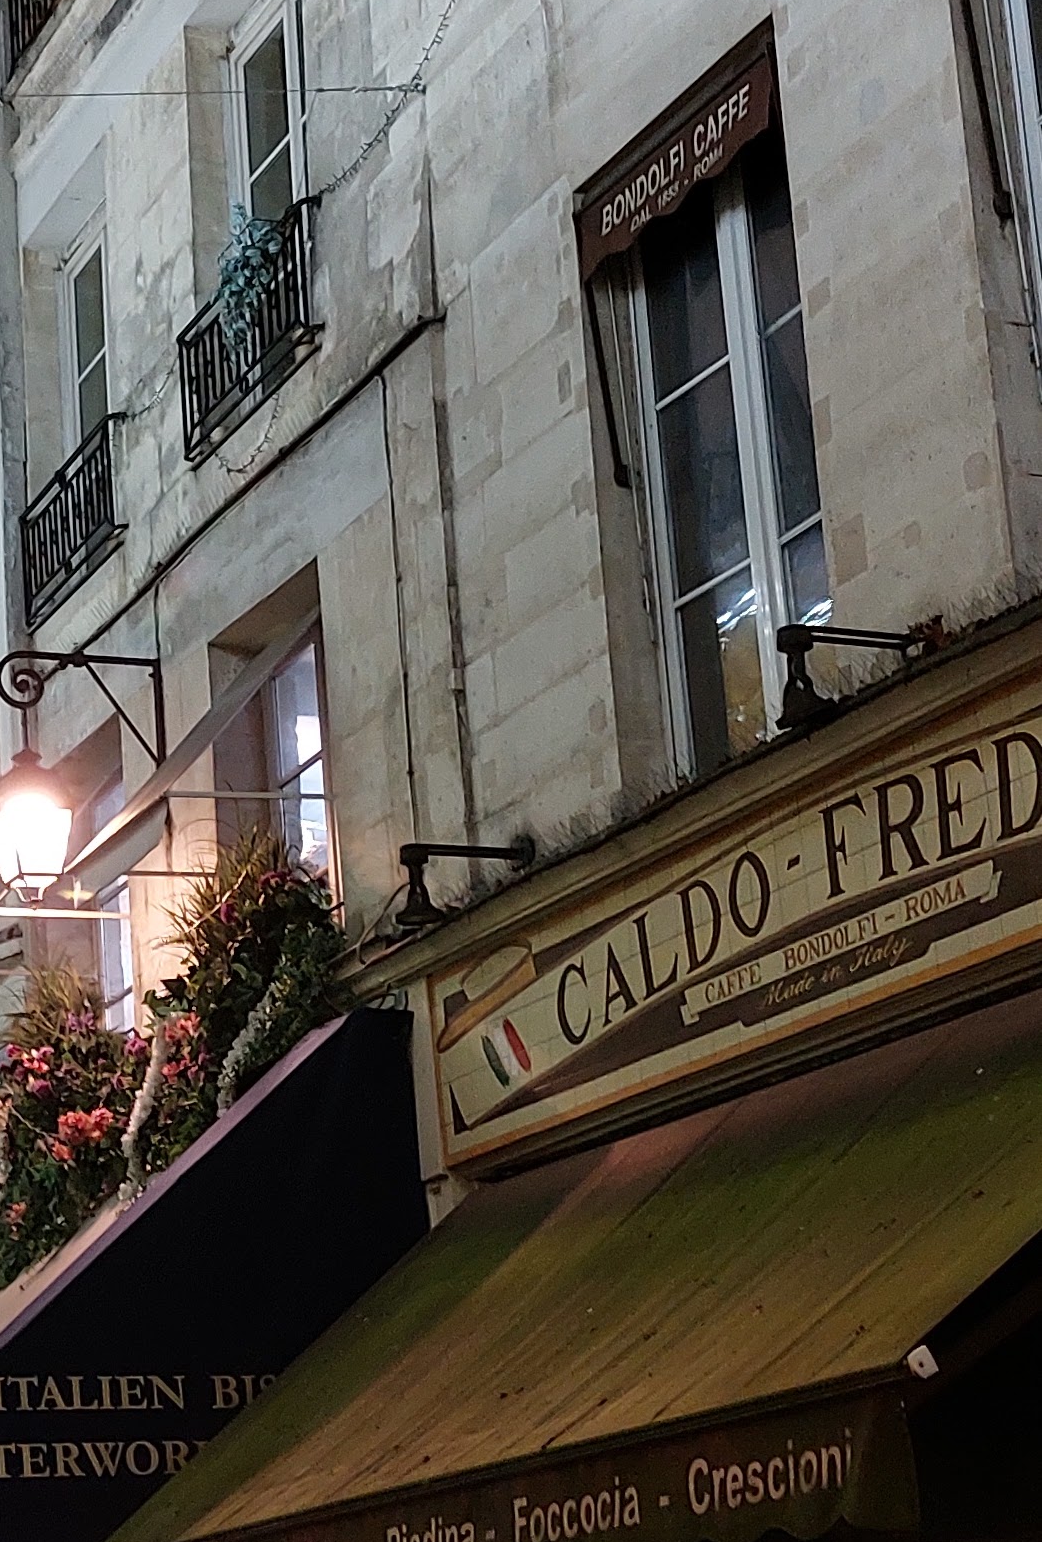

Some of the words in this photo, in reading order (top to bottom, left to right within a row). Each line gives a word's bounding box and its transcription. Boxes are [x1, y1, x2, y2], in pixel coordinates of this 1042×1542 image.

[600, 140, 685, 236] BONDOLFI
[693, 83, 750, 156] CAFFE
[630, 205, 653, 234] DAL
[556, 850, 771, 1046] CALDO
[818, 730, 1042, 900] FRED
[704, 963, 763, 1004] CAFFE
[782, 912, 879, 974] BONDOLFI
[903, 879, 968, 923] ROMA
[764, 973, 815, 1007] Made
[819, 961, 841, 983] in
[849, 934, 914, 973] Italy
[685, 1427, 852, 1517] Crescioni
